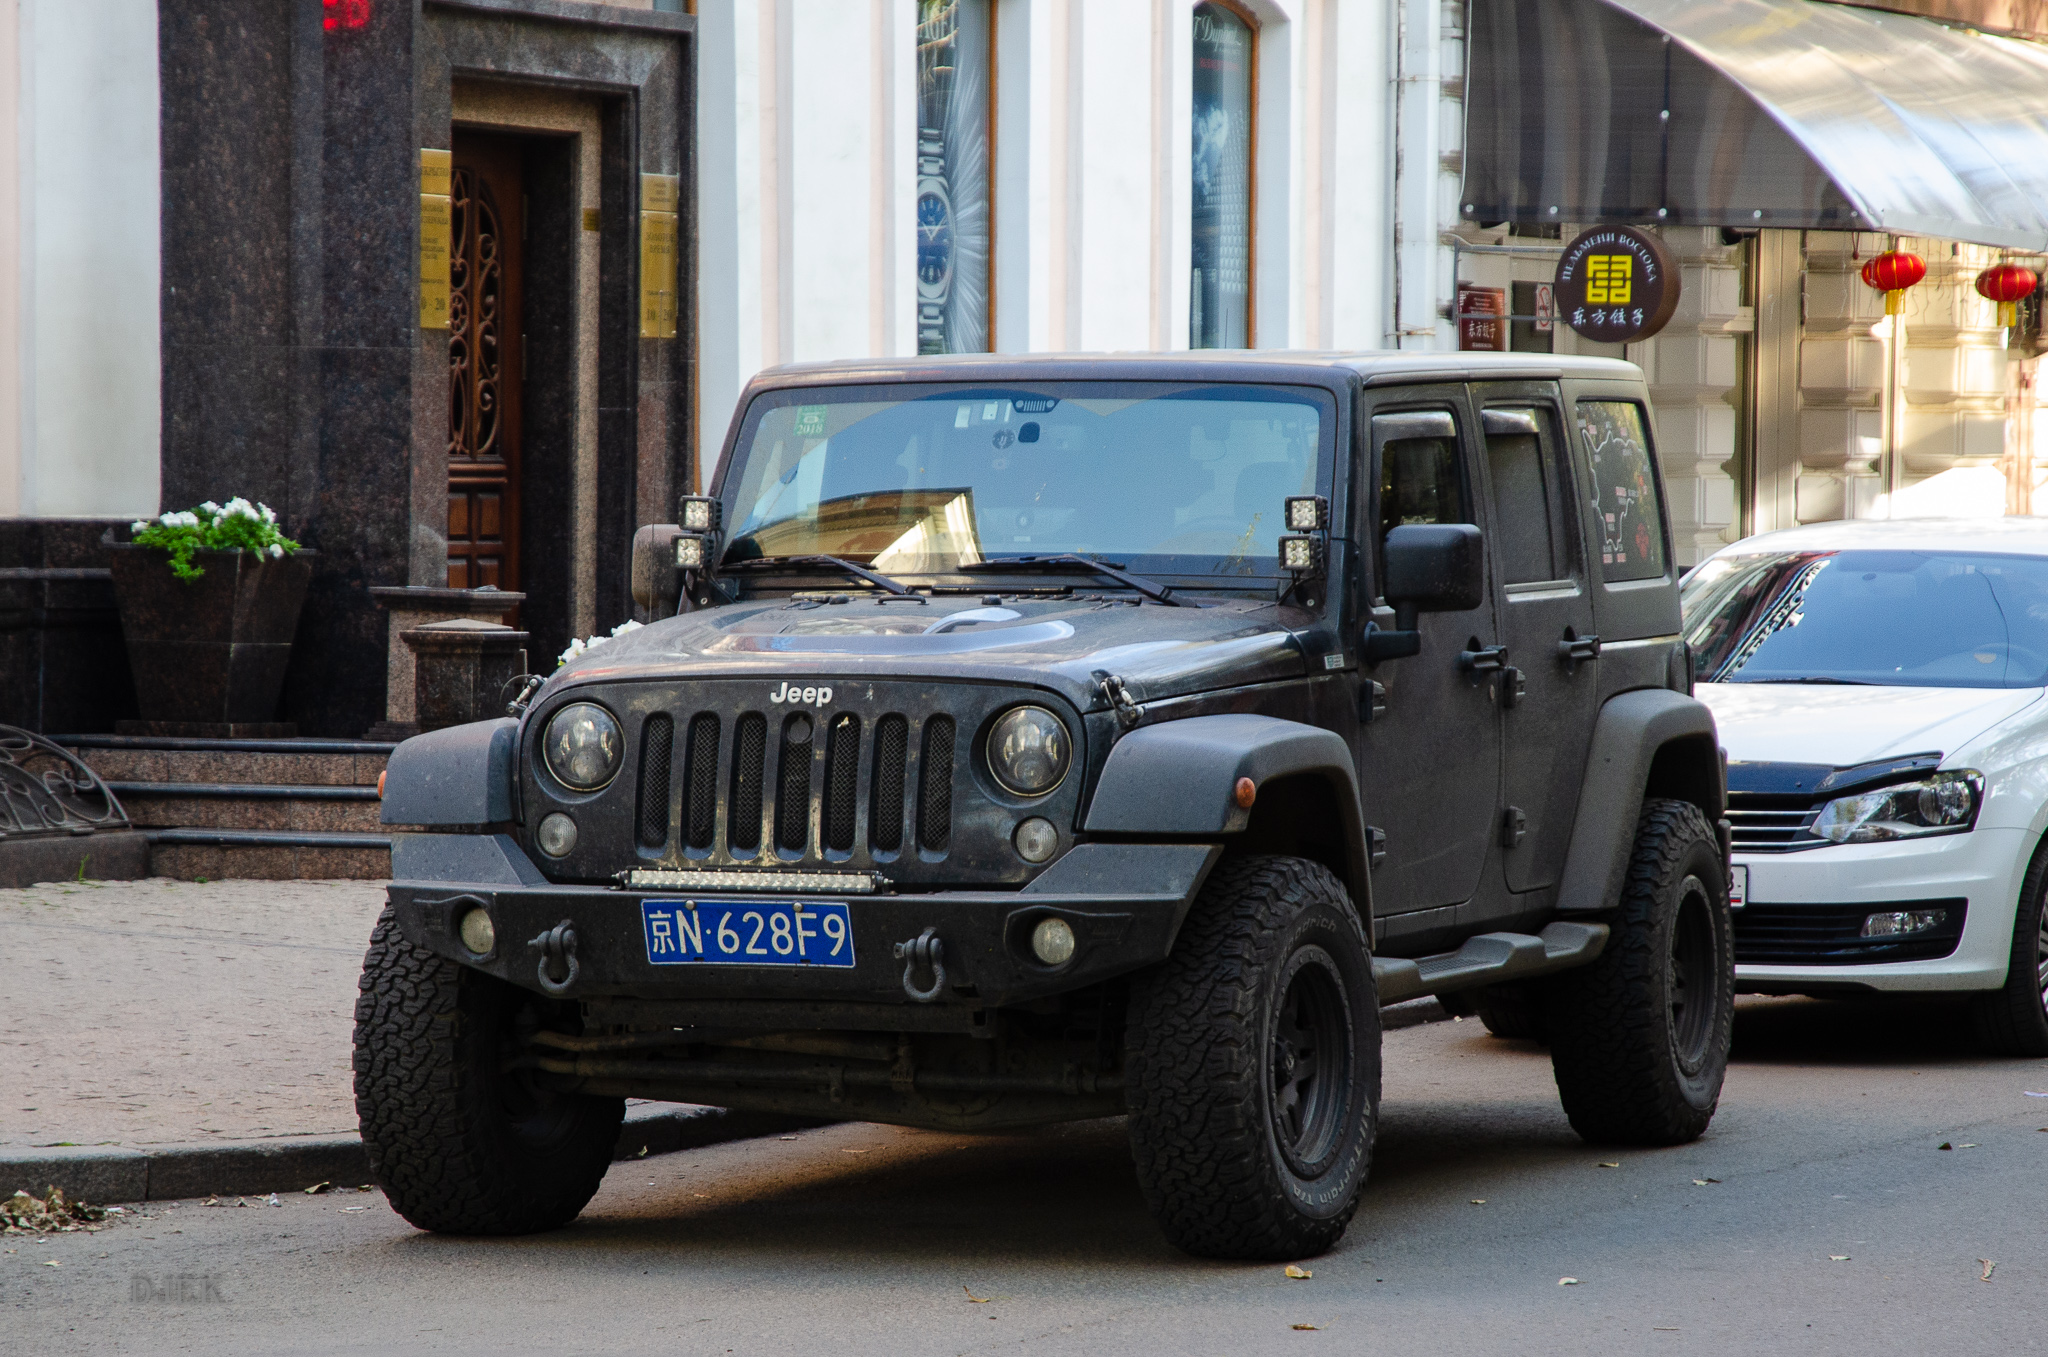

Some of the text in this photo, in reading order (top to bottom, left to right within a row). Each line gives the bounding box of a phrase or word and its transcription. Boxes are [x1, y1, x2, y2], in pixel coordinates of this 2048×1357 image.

[1562, 232, 1657, 282] ПЕЛЬМЕНИ ВОСТОКА
[797, 424, 823, 435] 2018
[770, 682, 833, 707] Jeep
